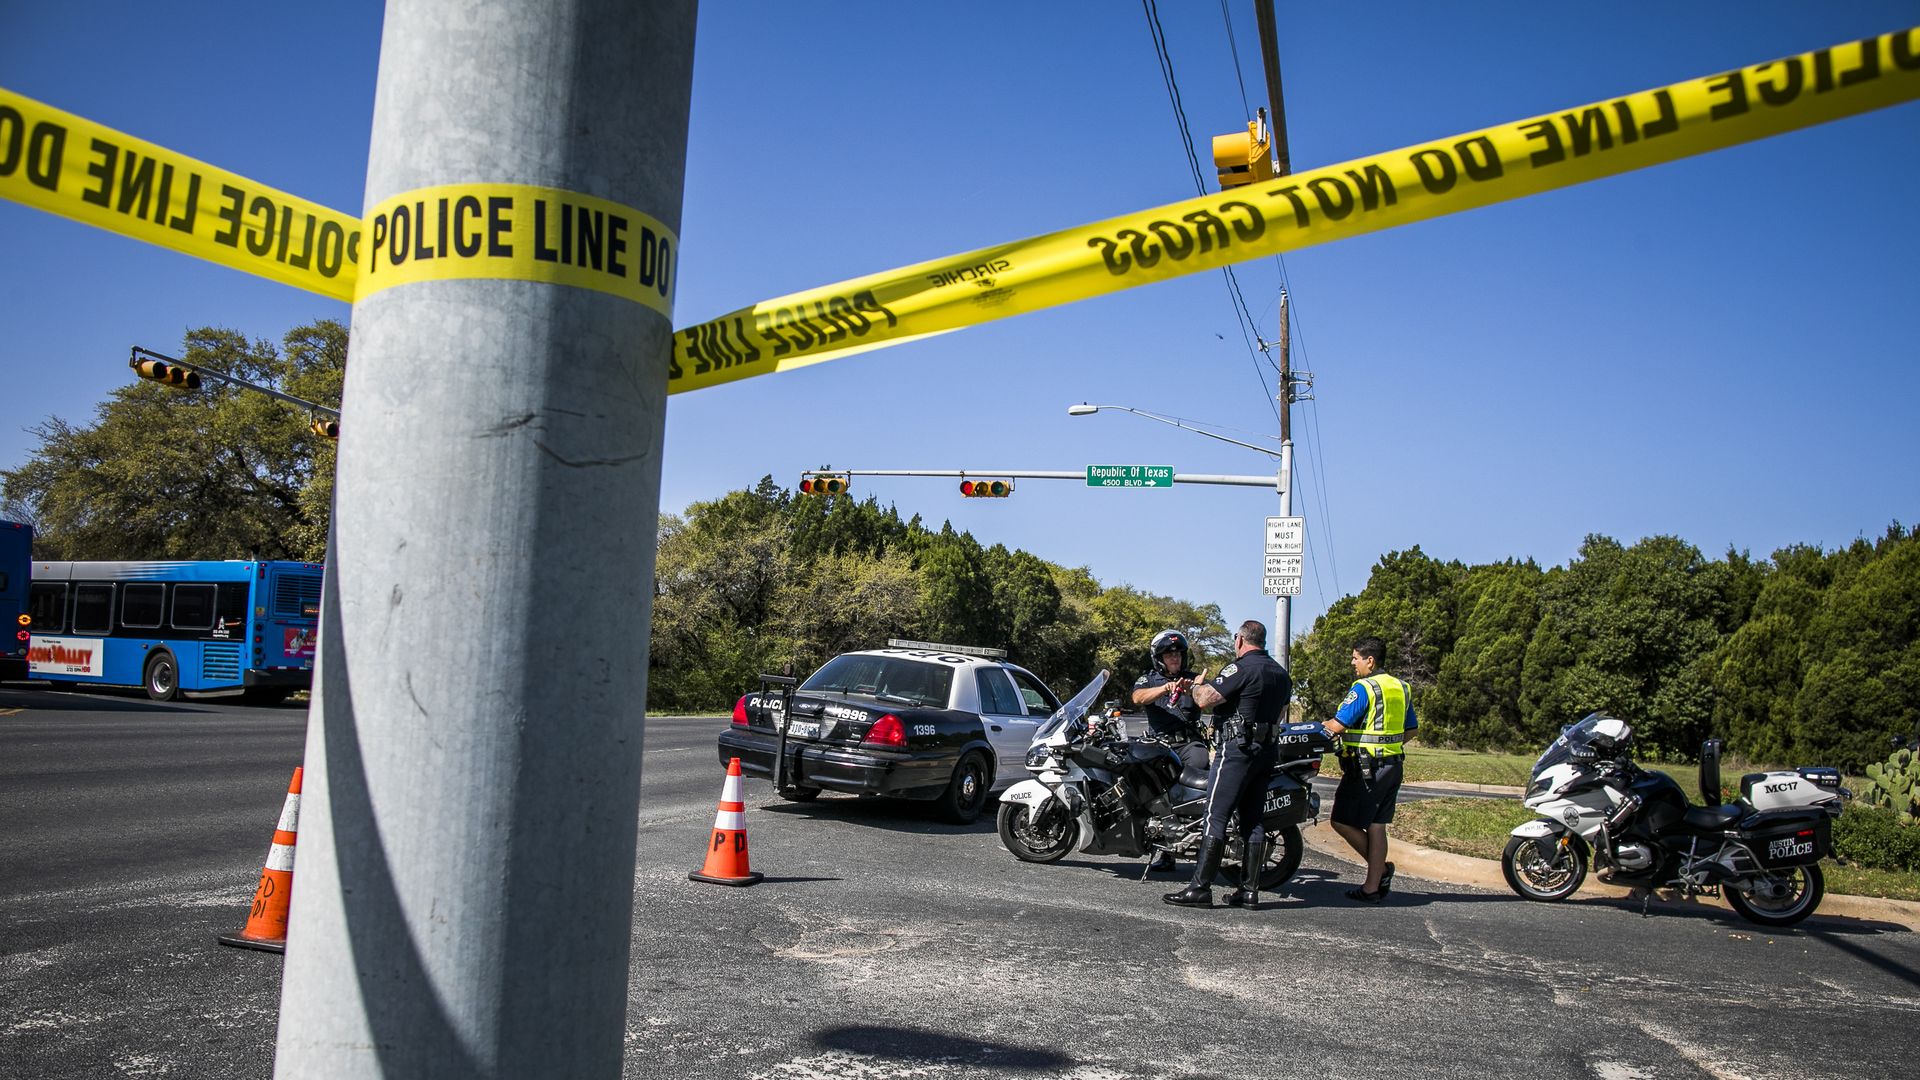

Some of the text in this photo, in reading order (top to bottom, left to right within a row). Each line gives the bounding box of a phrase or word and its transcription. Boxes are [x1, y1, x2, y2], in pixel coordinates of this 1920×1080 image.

[370, 195, 670, 297] POLICE LINE DO
[1091, 466, 1169, 478] Republic Of Texas
[1124, 479, 1143, 487] BLVD
[1268, 578, 1296, 586] EXCEPT
[1264, 586, 1300, 594] BICYCLES
[913, 724, 936, 736] 1396
[1278, 734, 1309, 745] MC16
[1764, 781, 1798, 794] MC17
[1010, 791, 1032, 801] POLICE
[1768, 837, 1795, 849] AUSTIN
[1768, 842, 1813, 860] POLICE
